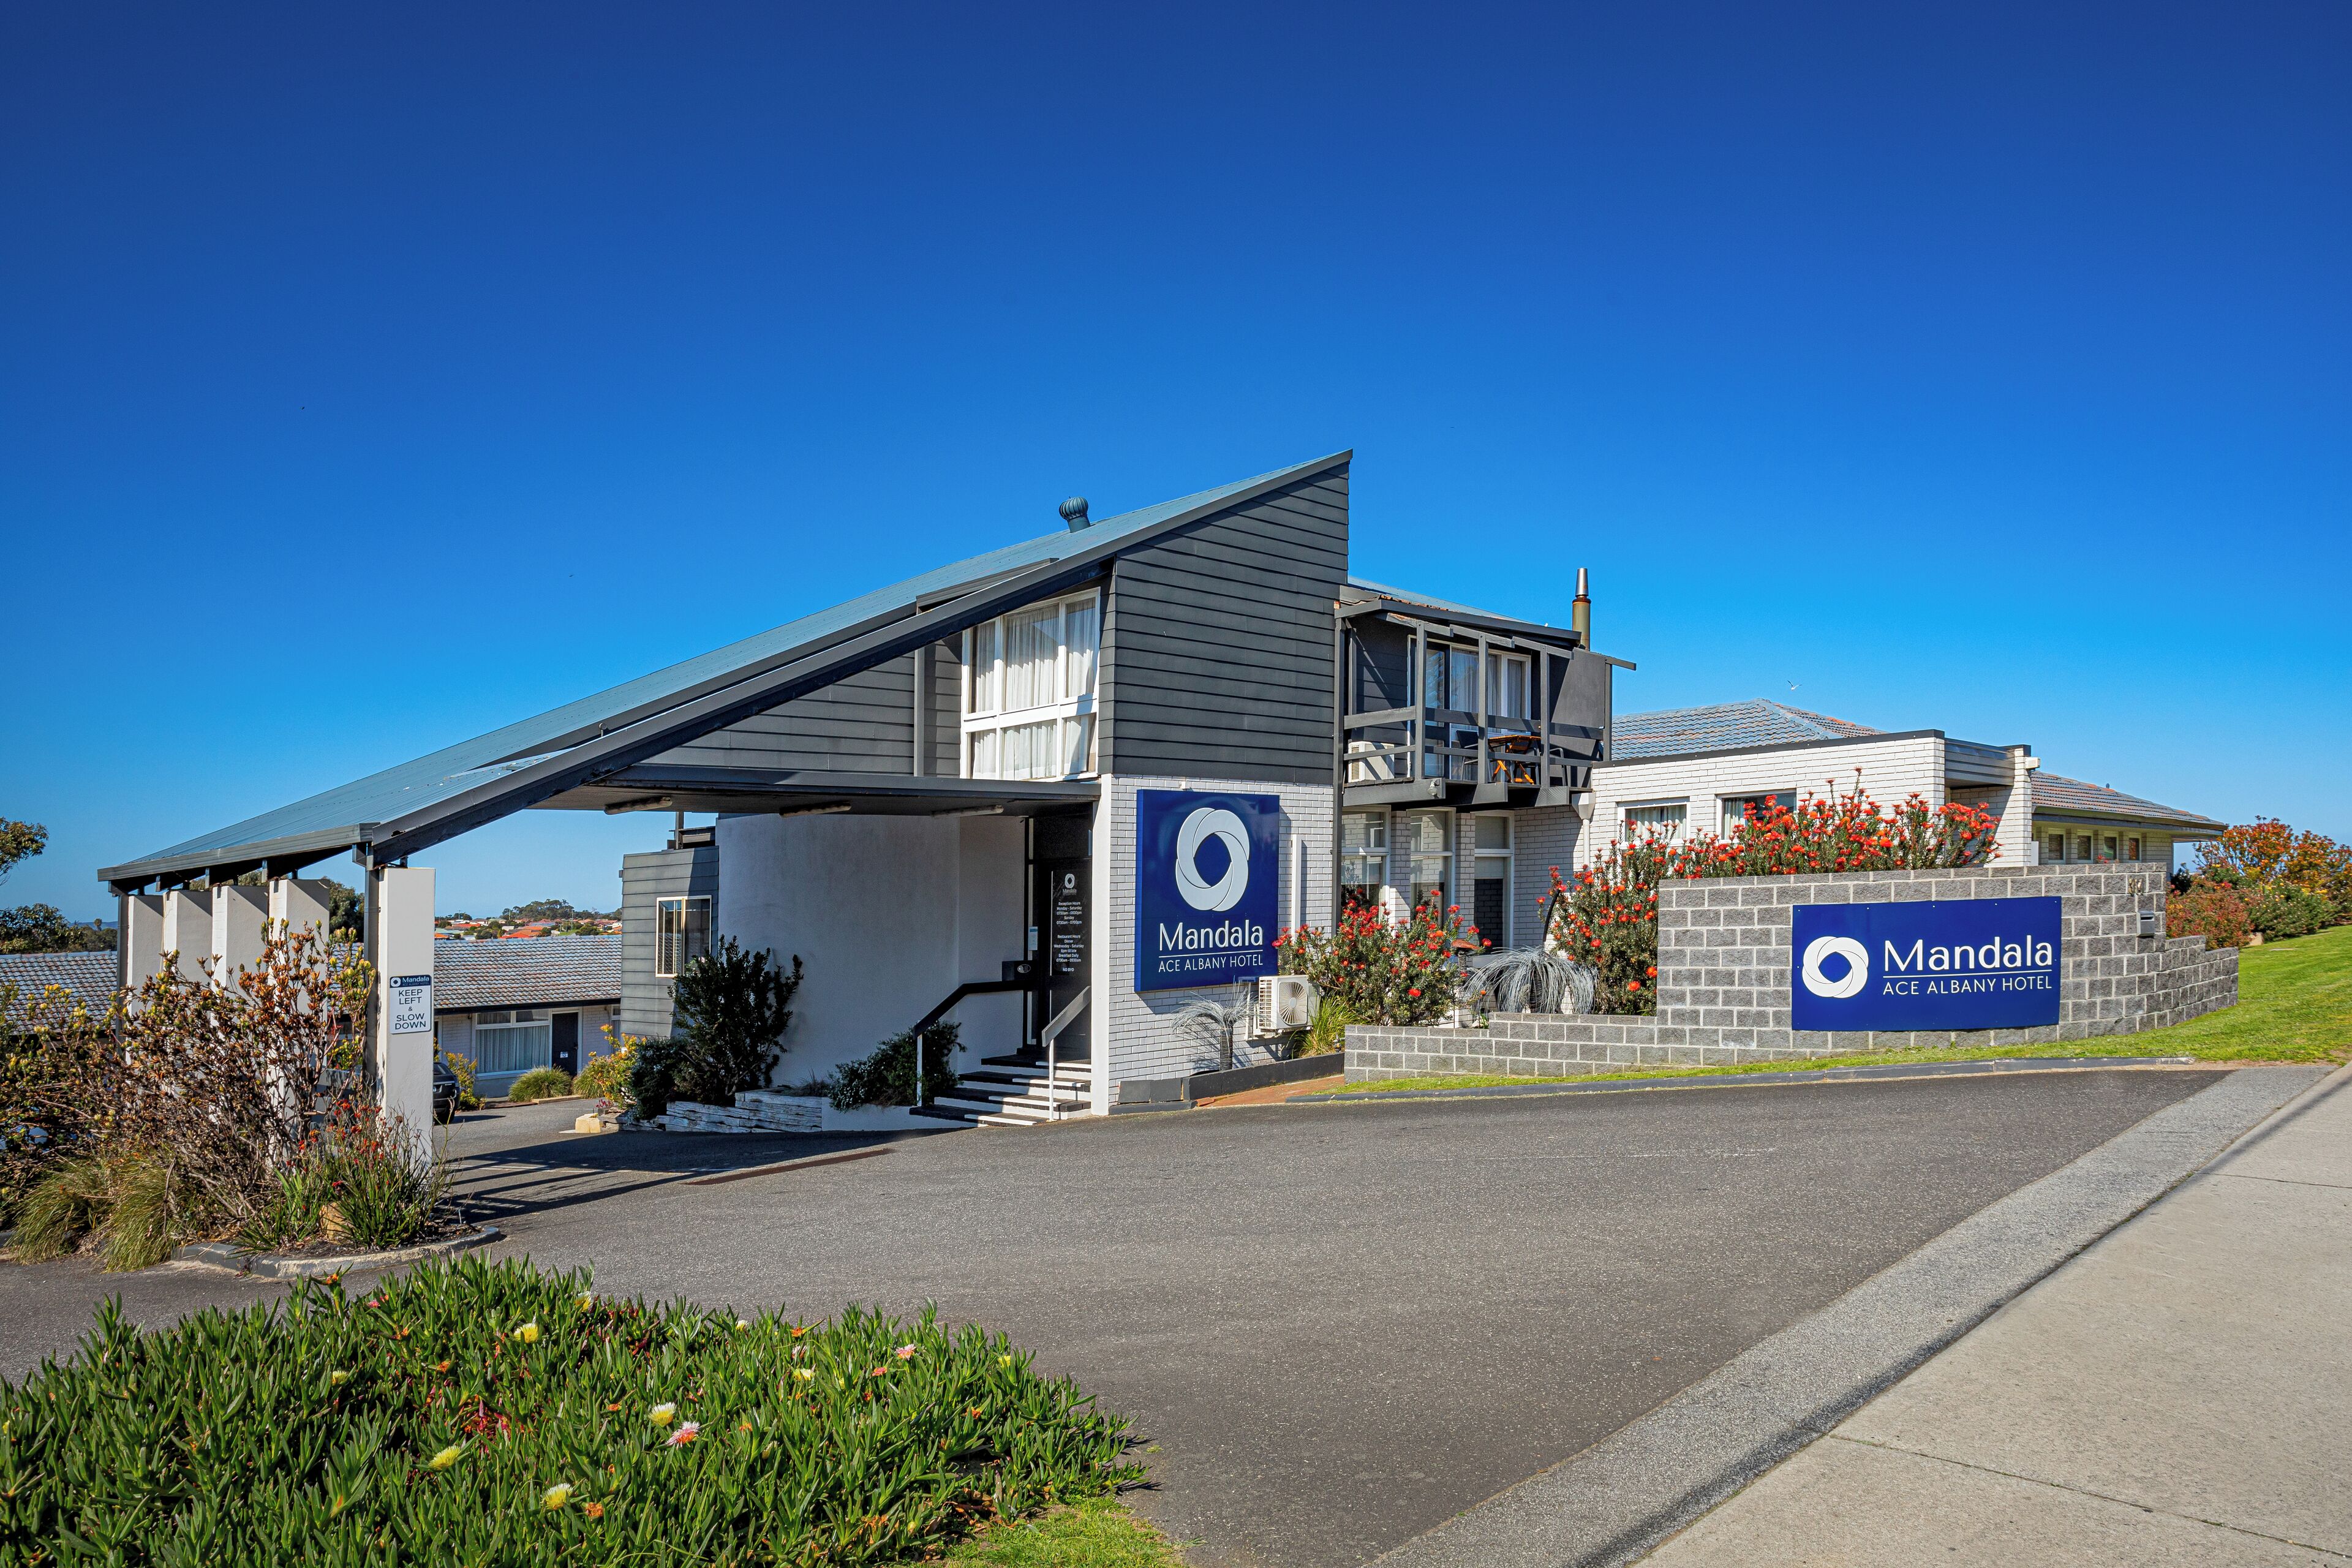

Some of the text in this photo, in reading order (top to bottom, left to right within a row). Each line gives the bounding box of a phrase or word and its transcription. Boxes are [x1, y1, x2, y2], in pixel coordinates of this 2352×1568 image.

[1159, 919, 1263, 951] Mandala
[1885, 935, 2052, 971] Mandala
[1159, 954, 1263, 973] ACE ALBANY HOTEL
[1883, 976, 2052, 995] ACE ALBANY HOTEL
[395, 1020, 426, 1030] DOWN
[396, 1013, 424, 1022] SLOW
